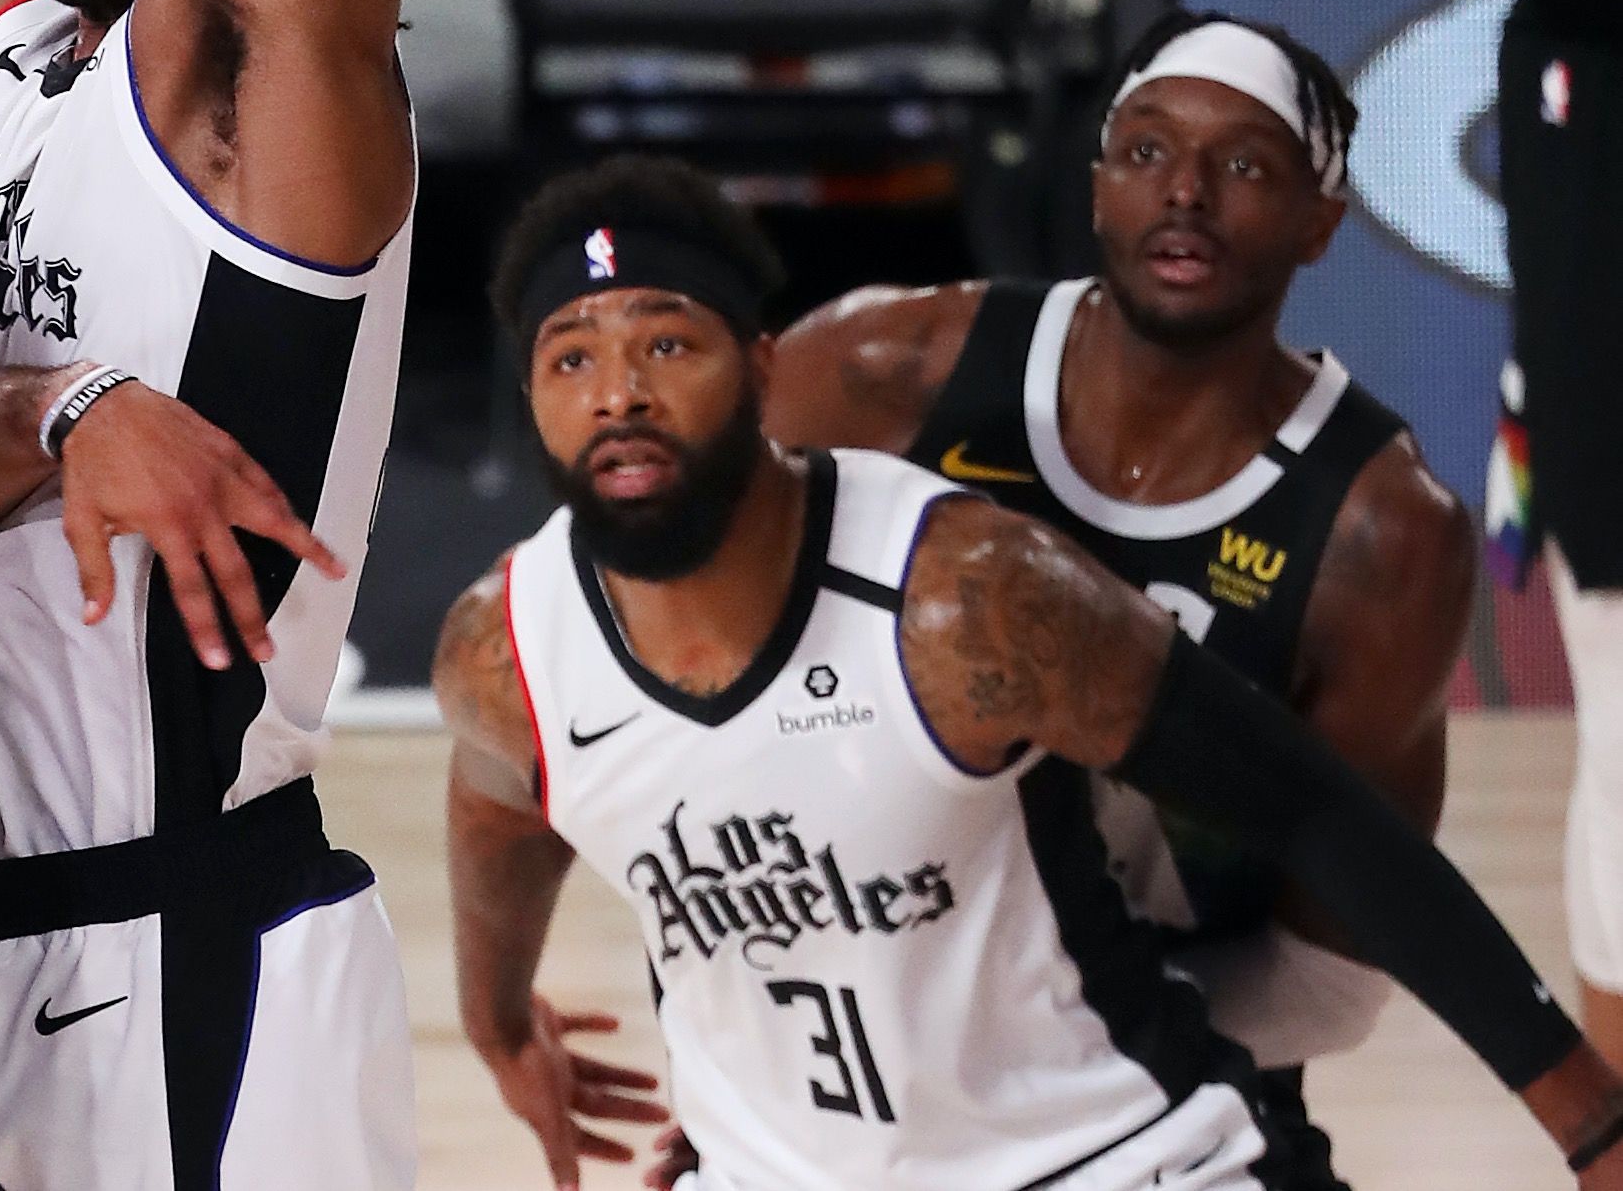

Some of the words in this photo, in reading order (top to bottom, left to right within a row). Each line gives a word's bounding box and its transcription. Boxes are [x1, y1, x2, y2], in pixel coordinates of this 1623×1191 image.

[1219, 528, 1287, 583] WU
[776, 702, 874, 736] bumble
[662, 799, 811, 881] Los
[627, 842, 955, 972] Angeles
[764, 980, 898, 1124] 31
